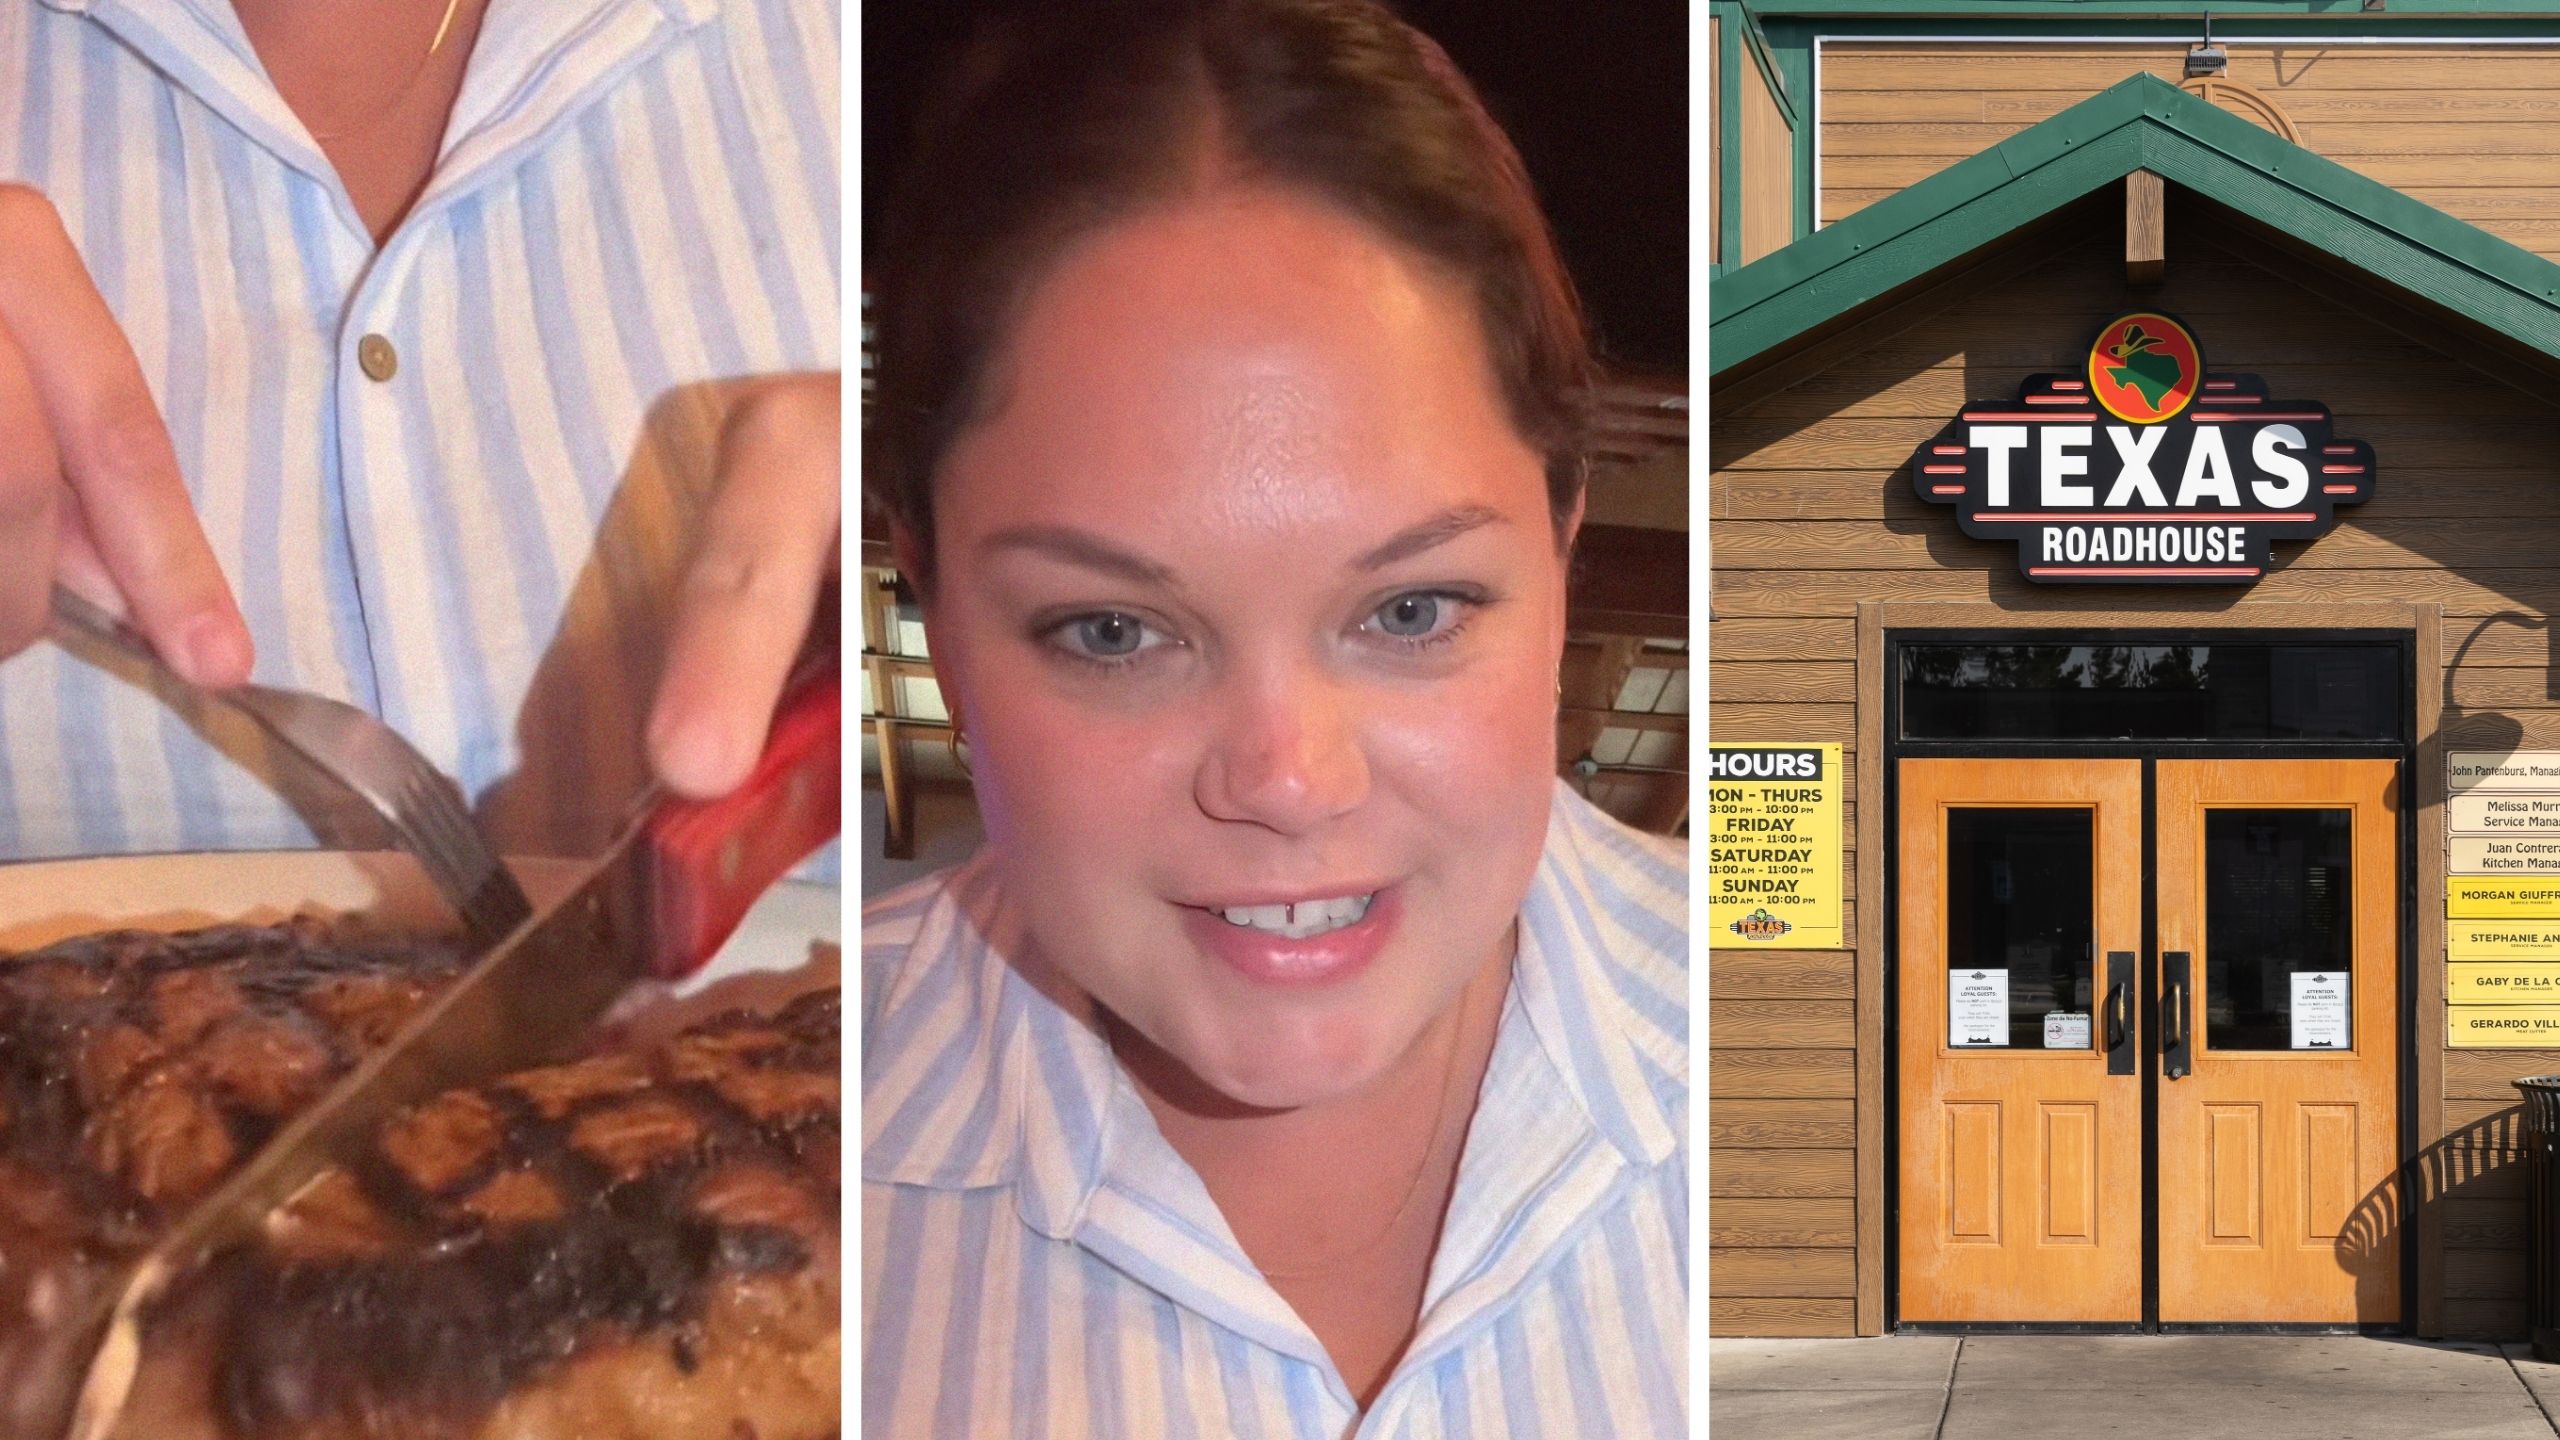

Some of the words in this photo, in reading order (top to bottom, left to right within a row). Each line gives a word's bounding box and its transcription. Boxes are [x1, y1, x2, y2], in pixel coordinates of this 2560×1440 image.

[1969, 424, 2309, 508] TEXAS
[2042, 526, 2246, 562] ROADHOUSE
[1709, 753, 1816, 777] HOURS
[2452, 766, 2472, 776] John
[2475, 766, 2527, 777] Pantenburg,
[1760, 789, 1823, 802] THURS
[1709, 805, 1737, 814] 3:00
[1766, 805, 1798, 814] 10:00
[2487, 801, 2528, 811] Melissa
[1727, 818, 1795, 831] FRIDAY
[2484, 817, 2525, 826] Service
[1709, 835, 1737, 843] 3:00
[1767, 835, 1796, 843] 11:00
[2487, 843, 2512, 853] Juan
[2516, 843, 2560, 853] Contrer
[1710, 849, 1812, 862] SATURDAY
[2482, 858, 2523, 868] Kitchen
[1709, 866, 1738, 874] 11:00
[1768, 866, 1798, 874] 11:00
[1722, 879, 1799, 892] SUNDAY
[1709, 896, 1737, 904] 11:00
[1767, 896, 1800, 904] 10:00
[2461, 891, 2515, 899] MORGAN
[2519, 891, 2560, 899] GIUFFR
[1738, 921, 1784, 934] TEXAS
[2471, 934, 2538, 942] STEPHANIE
[2543, 934, 2560, 942] AN
[2476, 977, 2509, 986] GABY
[2514, 977, 2529, 986] DE
[2534, 977, 2550, 986] LA
[2470, 1020, 2529, 1028] GERARDO
[2534, 1020, 2560, 1028] VILL
